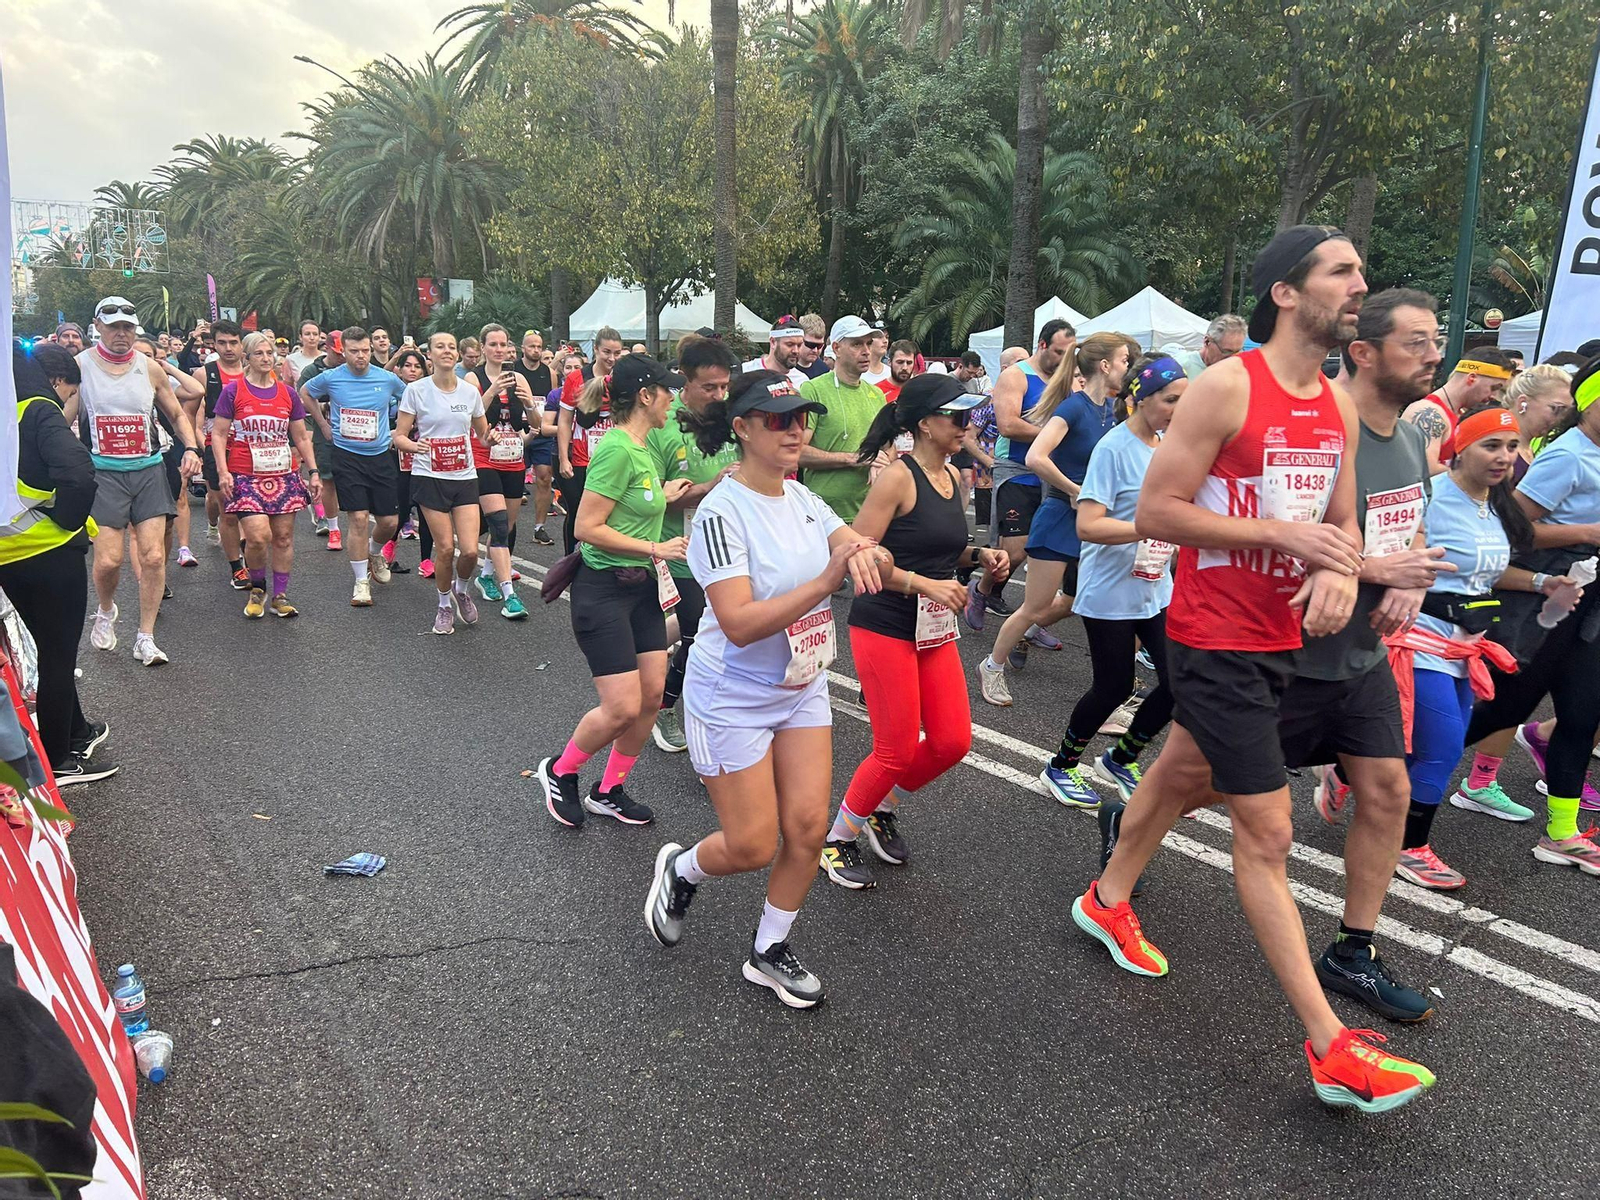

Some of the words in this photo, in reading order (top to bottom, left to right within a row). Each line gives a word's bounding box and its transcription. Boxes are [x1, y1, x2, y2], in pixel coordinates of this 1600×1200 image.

[105, 425, 137, 433] 11692
[259, 449, 281, 457] 28567
[437, 446, 461, 454] 12684
[1290, 454, 1334, 467] GENERALI
[1285, 474, 1326, 490] 18438
[1381, 487, 1419, 505] GENERALI
[1377, 507, 1416, 528] 18494
[800, 630, 827, 654] 27306
